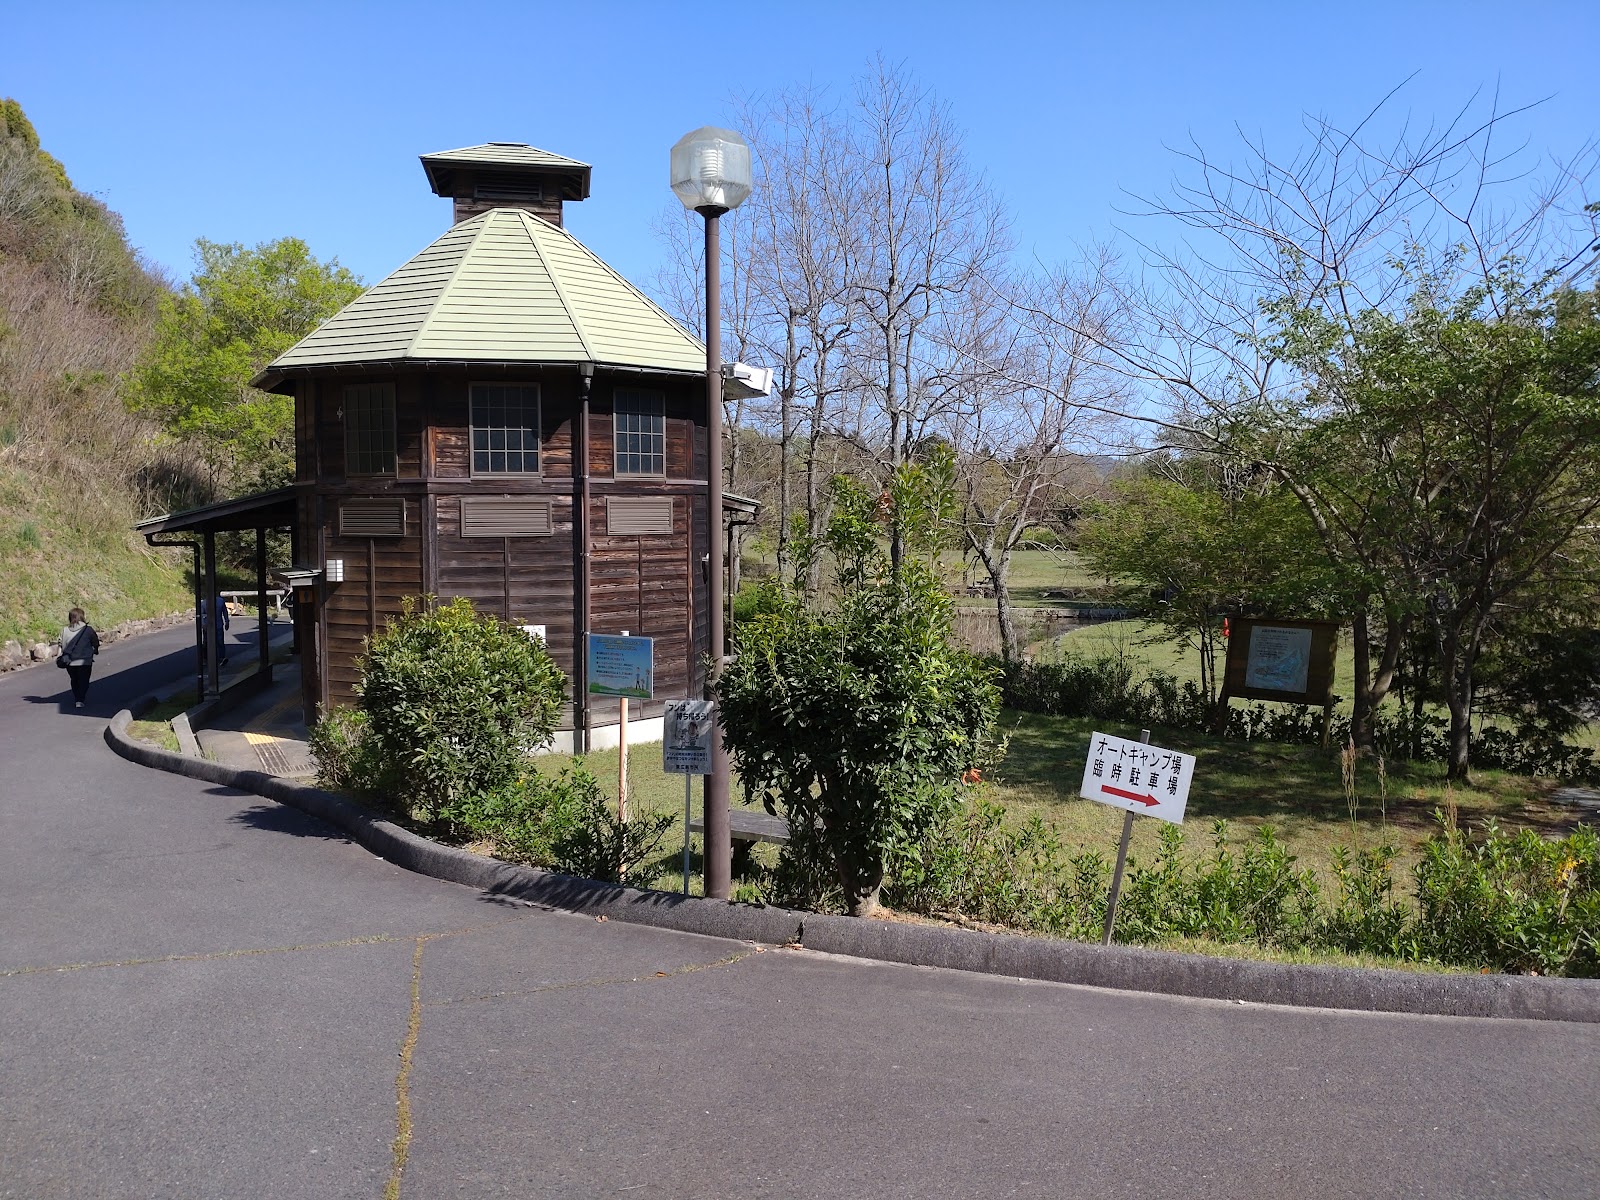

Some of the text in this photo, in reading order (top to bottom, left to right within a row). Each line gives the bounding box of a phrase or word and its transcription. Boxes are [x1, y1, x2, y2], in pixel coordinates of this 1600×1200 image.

[669, 704, 686, 712] フンは
[1097, 738, 1182, 775] オートキャンプ場
[1092, 758, 1178, 796] 臨時駐車場
